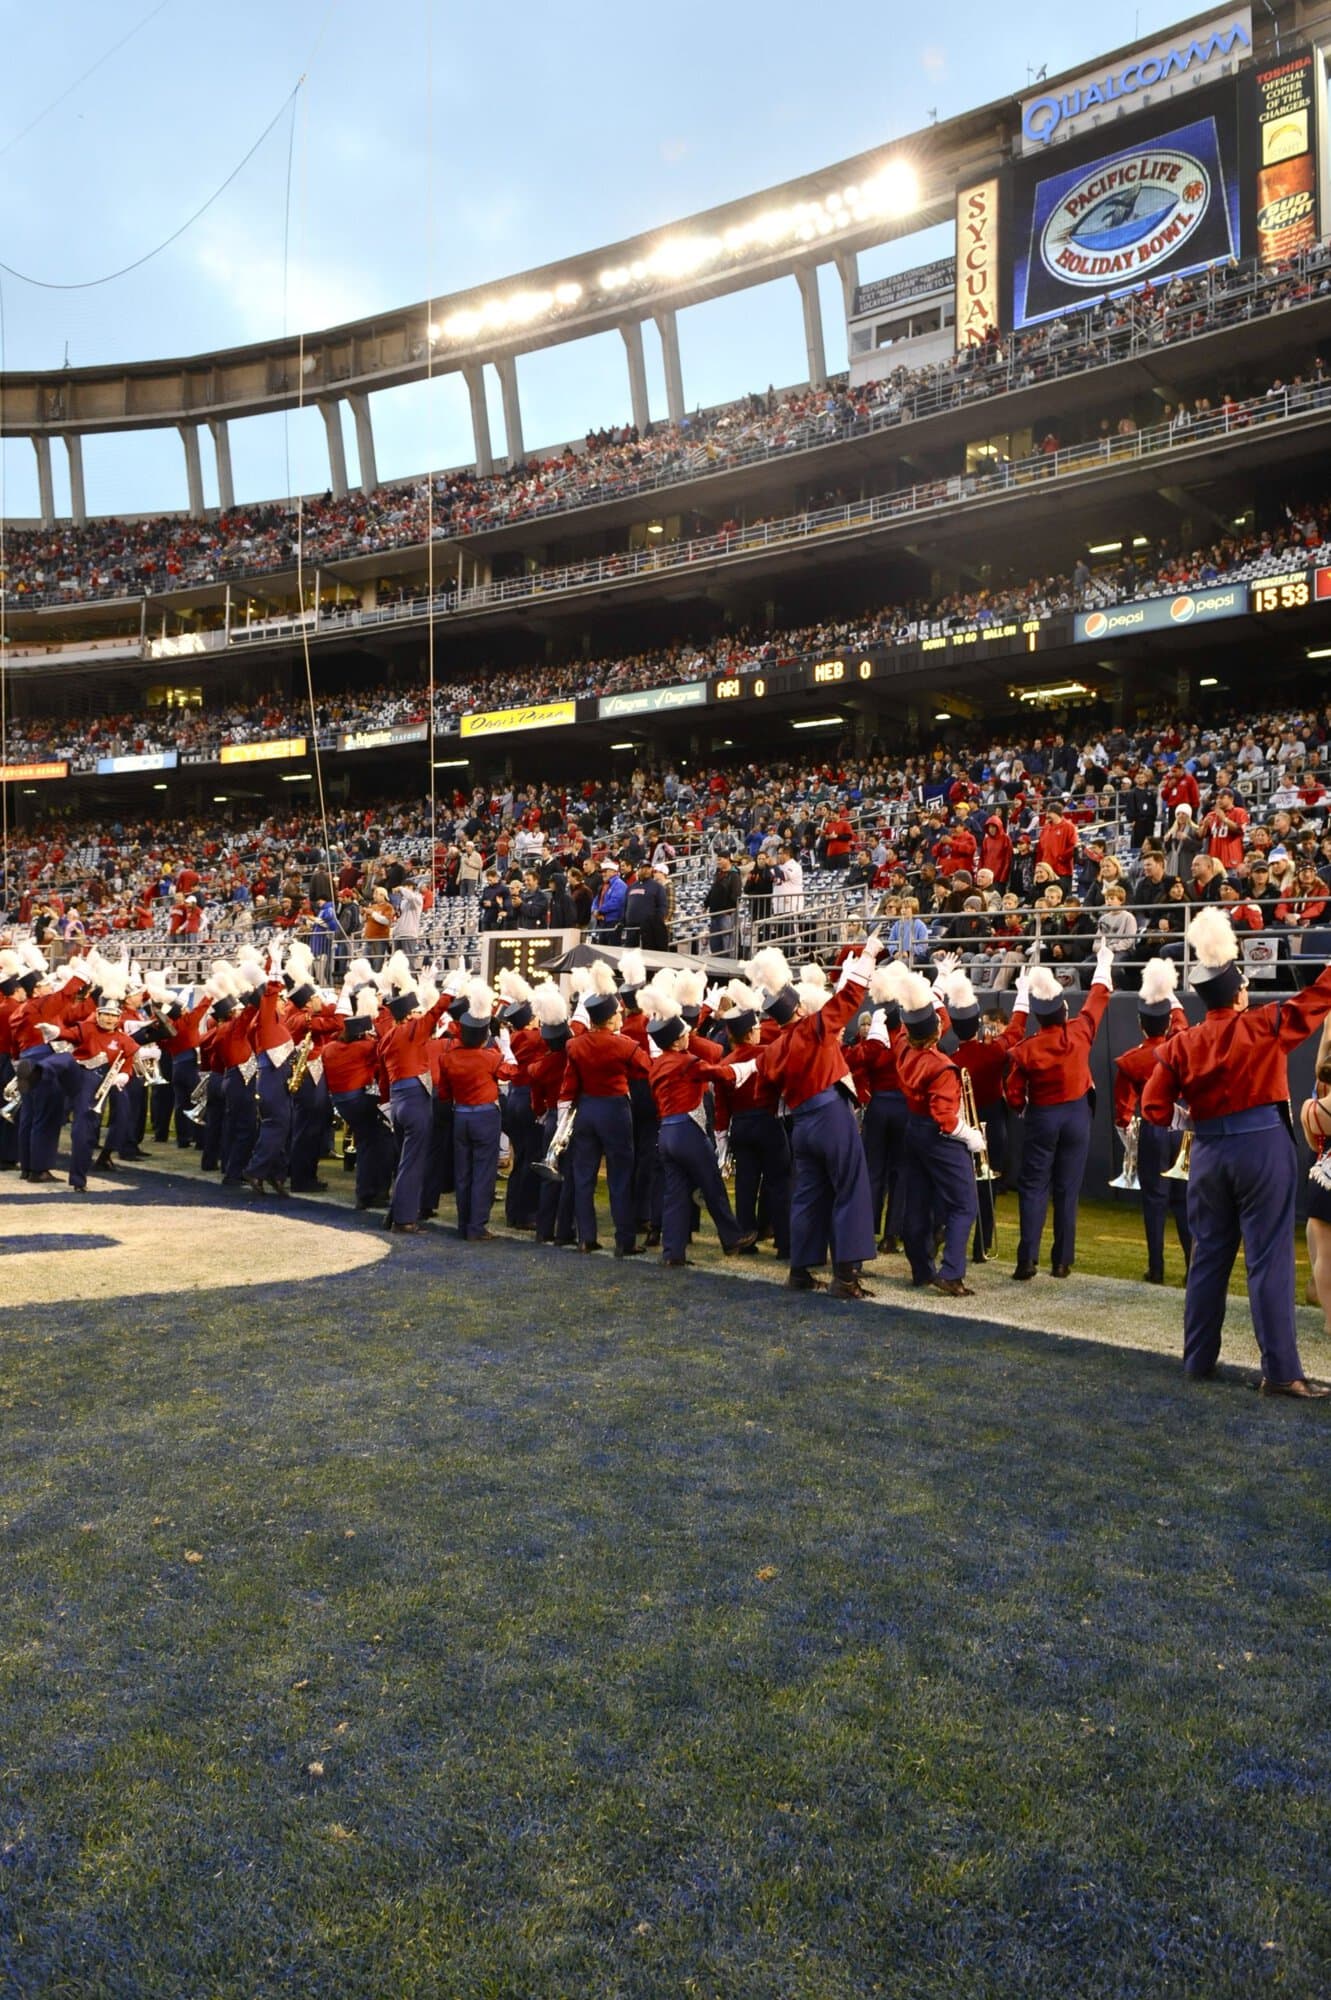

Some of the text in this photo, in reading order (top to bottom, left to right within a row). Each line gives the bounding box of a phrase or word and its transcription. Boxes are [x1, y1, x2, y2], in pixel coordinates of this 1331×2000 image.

[1256, 56, 1313, 85] TOSHIBA
[1262, 69, 1307, 92] OFFICIAL
[1023, 22, 1250, 144] QUALCOMM
[1266, 80, 1303, 100] COPIER
[1259, 96, 1312, 123] CHARGERS
[1266, 90, 1303, 110] OF THE
[1260, 199, 1315, 229] LIGHT
[1266, 191, 1310, 218] BUD
[1055, 211, 1195, 275] HOLIDAY BOWL
[965, 191, 989, 349] SYCUAN
[1195, 593, 1234, 615] pepsi
[1108, 609, 1144, 630] pepsi
[952, 634, 963, 645] TO
[965, 631, 977, 643] GO
[860, 661, 871, 679] 0
[717, 679, 765, 698] ARI 0
